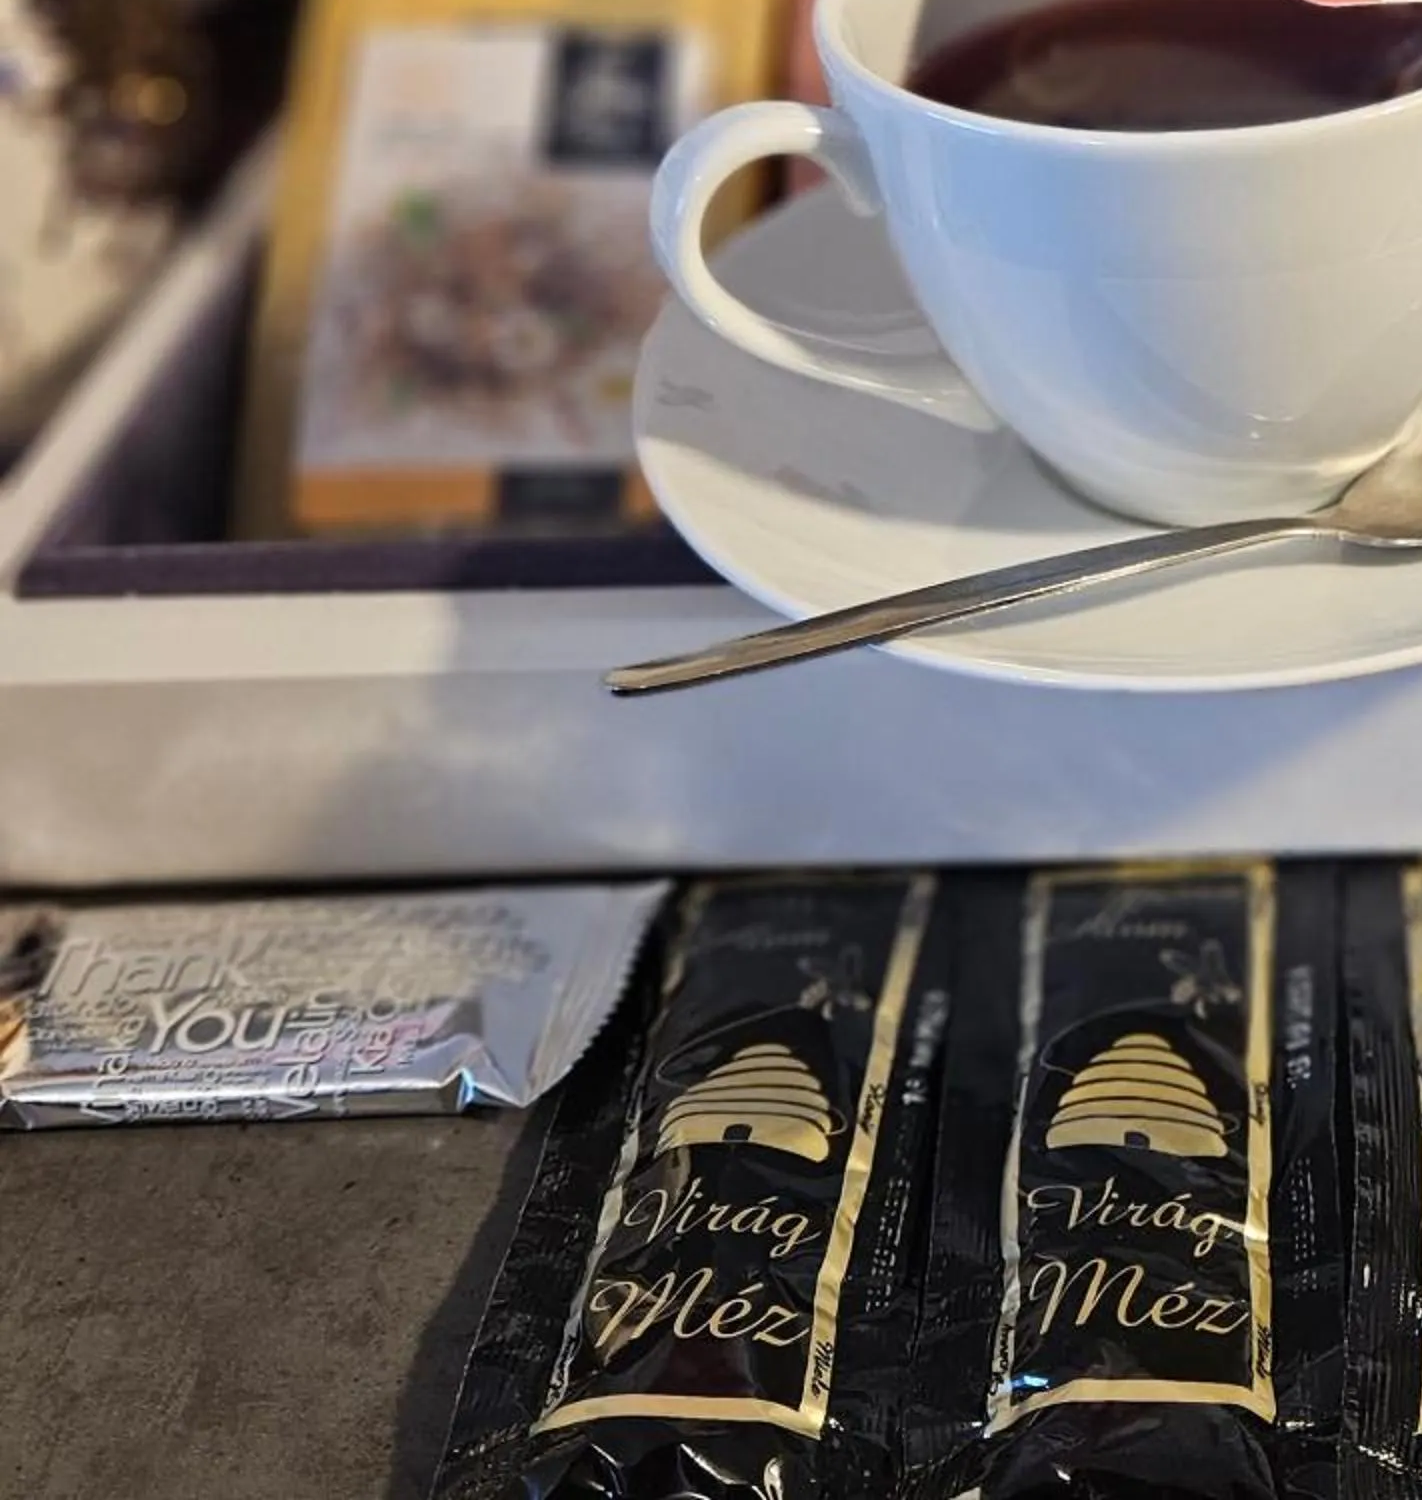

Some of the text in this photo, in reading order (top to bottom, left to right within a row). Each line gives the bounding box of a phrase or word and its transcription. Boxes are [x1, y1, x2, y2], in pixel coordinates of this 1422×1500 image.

[38, 926, 280, 998] Thank
[149, 990, 289, 1056] You
[623, 1177, 821, 1259] Virág
[1027, 1176, 1235, 1258] Virág
[589, 1267, 810, 1348] Méz
[1029, 1257, 1249, 1336] Méz
